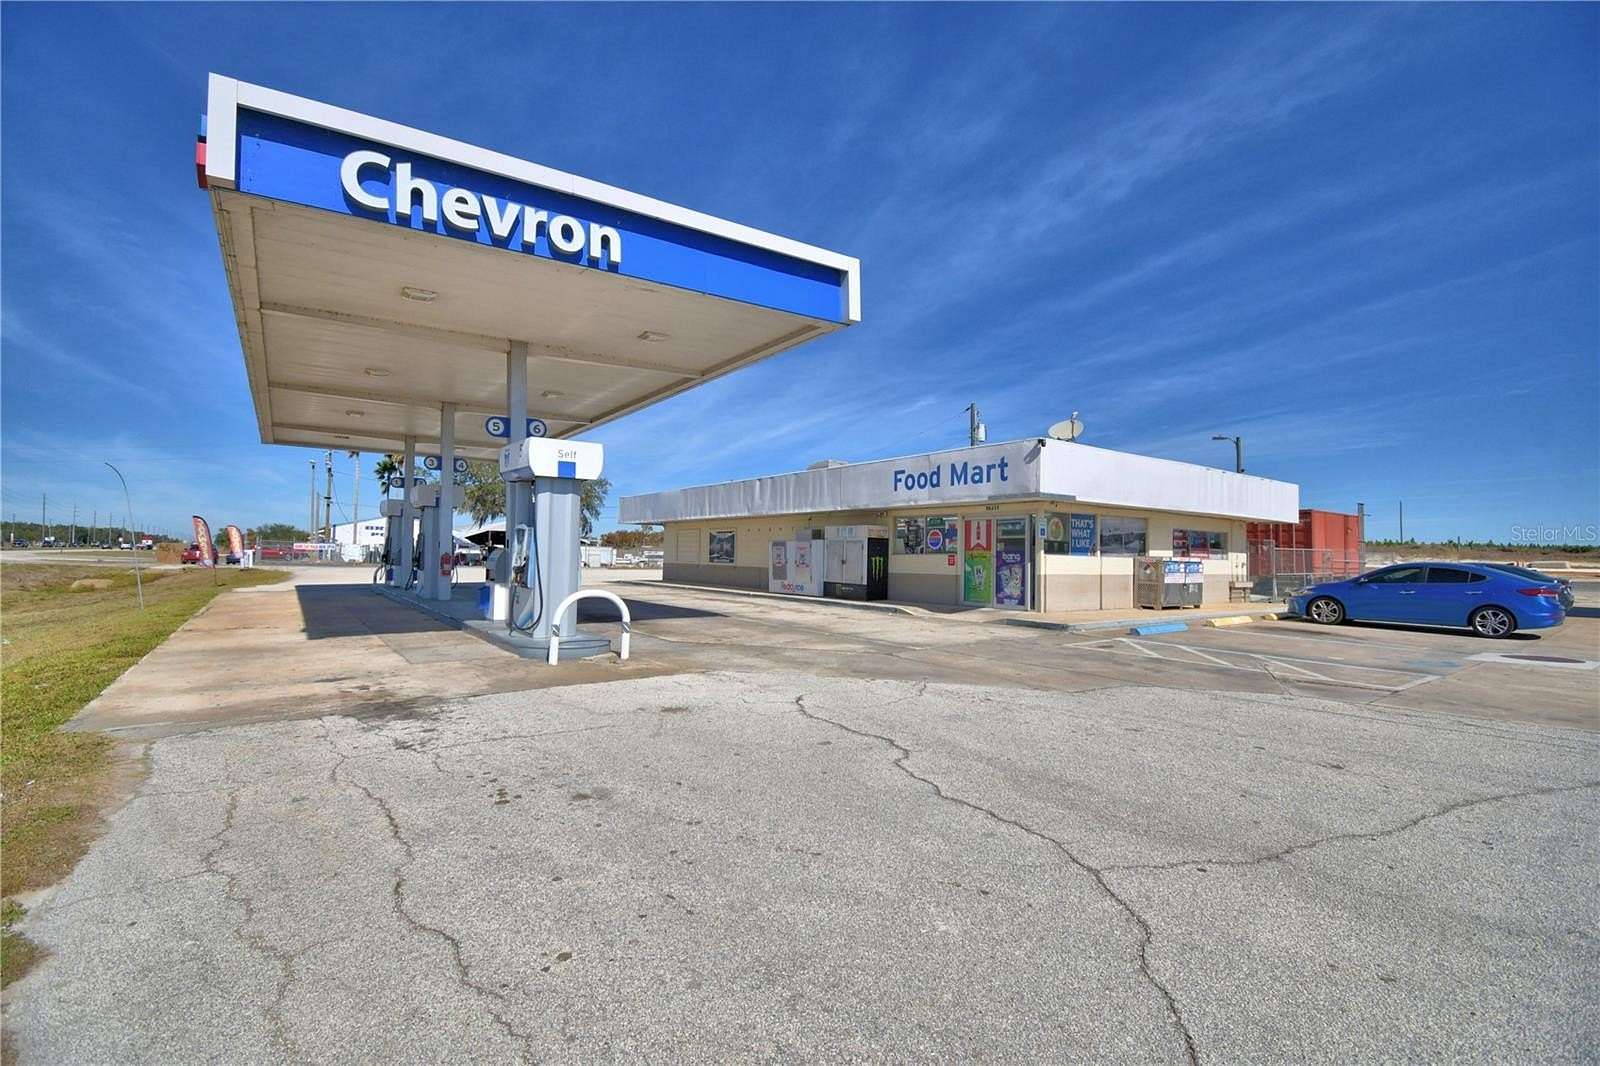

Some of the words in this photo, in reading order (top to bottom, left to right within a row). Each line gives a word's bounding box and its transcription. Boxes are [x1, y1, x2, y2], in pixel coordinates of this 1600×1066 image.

[340, 149, 622, 264] Chevron
[492, 421, 501, 432] 5
[533, 424, 541, 434] 6
[557, 448, 577, 459] Self
[428, 458, 435, 467] 3
[458, 461, 465, 469] 4
[893, 463, 941, 492] Food
[950, 456, 1009, 487] Mart
[1071, 519, 1094, 529] THAT'S
[1071, 528, 1091, 538] WHAT
[1076, 539, 1091, 548] LIKE
